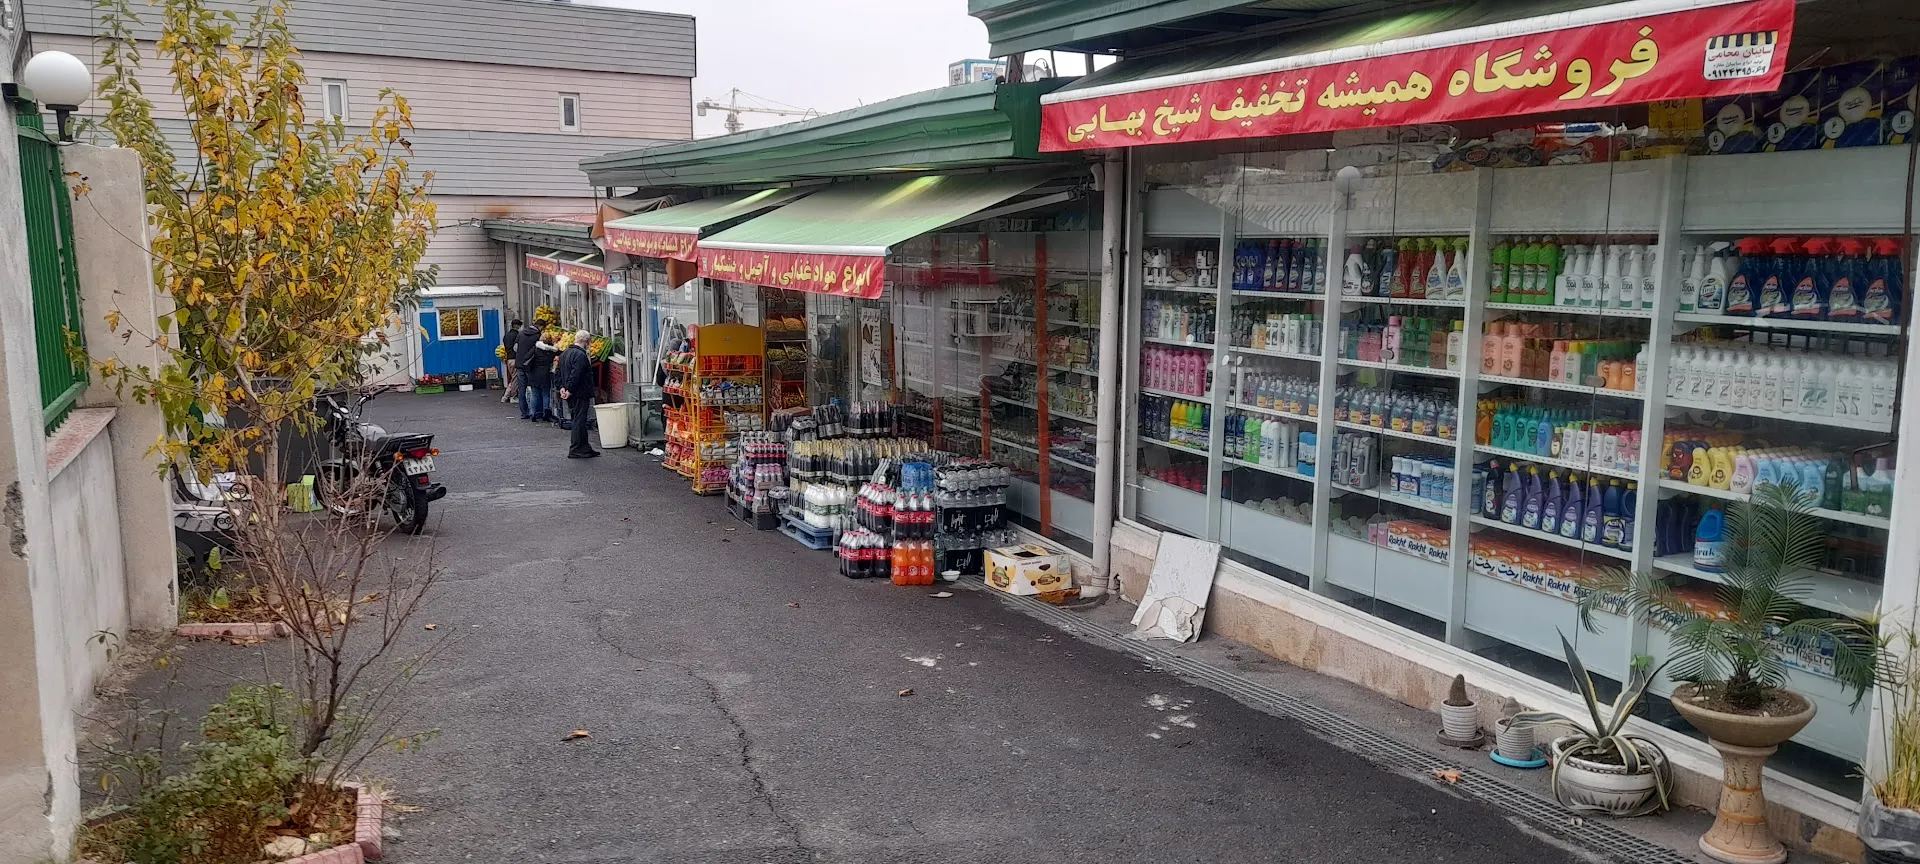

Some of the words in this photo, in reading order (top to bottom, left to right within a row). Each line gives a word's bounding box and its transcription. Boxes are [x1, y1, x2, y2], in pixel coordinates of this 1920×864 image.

[1447, 24, 1658, 99] فروشگاه
[1708, 49, 1740, 62] محامی
[1743, 46, 1772, 59] سایبان
[1209, 78, 1309, 127] تخفیف
[1316, 69, 1433, 117] همیشه
[1067, 103, 1147, 143] بهایی
[1152, 92, 1202, 136] شیخ
[709, 253, 737, 277] خشکبار
[739, 263, 745, 280] و
[745, 254, 770, 282] آجیل
[771, 266, 777, 285] و
[778, 258, 812, 286] غذایی
[814, 262, 837, 291] مواد
[841, 263, 873, 294] انواع
[1388, 535, 1407, 549] Rakht
[1408, 537, 1427, 554] Rakht
[1428, 547, 1448, 561] Rakht
[1475, 556, 1495, 572] رخت
[1498, 563, 1519, 580] رخت
[1522, 571, 1544, 586] Rakht
[1547, 576, 1571, 593] Rakht
